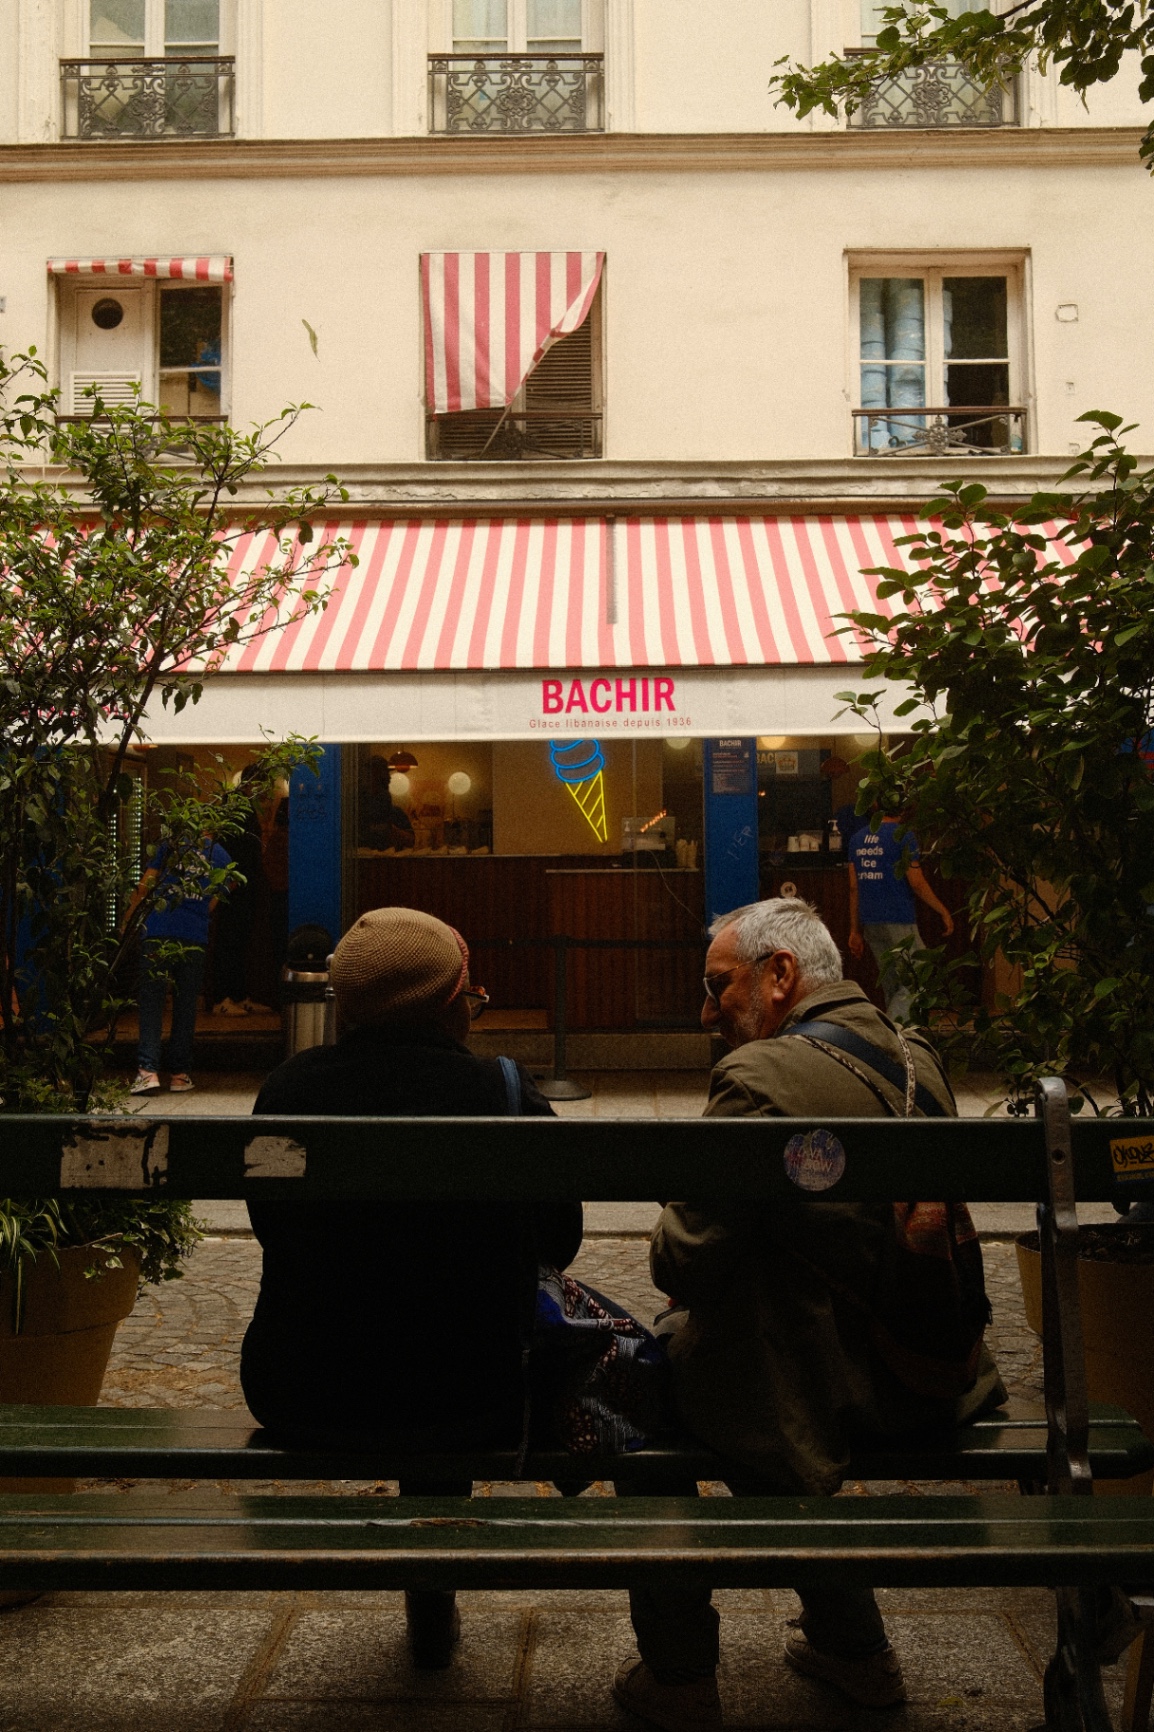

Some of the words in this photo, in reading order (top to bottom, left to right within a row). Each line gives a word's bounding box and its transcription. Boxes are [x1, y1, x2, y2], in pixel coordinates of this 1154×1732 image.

[542, 677, 676, 714] BACHIR
[529, 719, 560, 728] Glace
[566, 718, 617, 728] libanaise
[624, 718, 661, 729] depuis
[667, 716, 692, 727] 1936
[719, 739, 741, 747] BACHIR
[864, 834, 879, 843] life
[856, 846, 884, 856] needs
